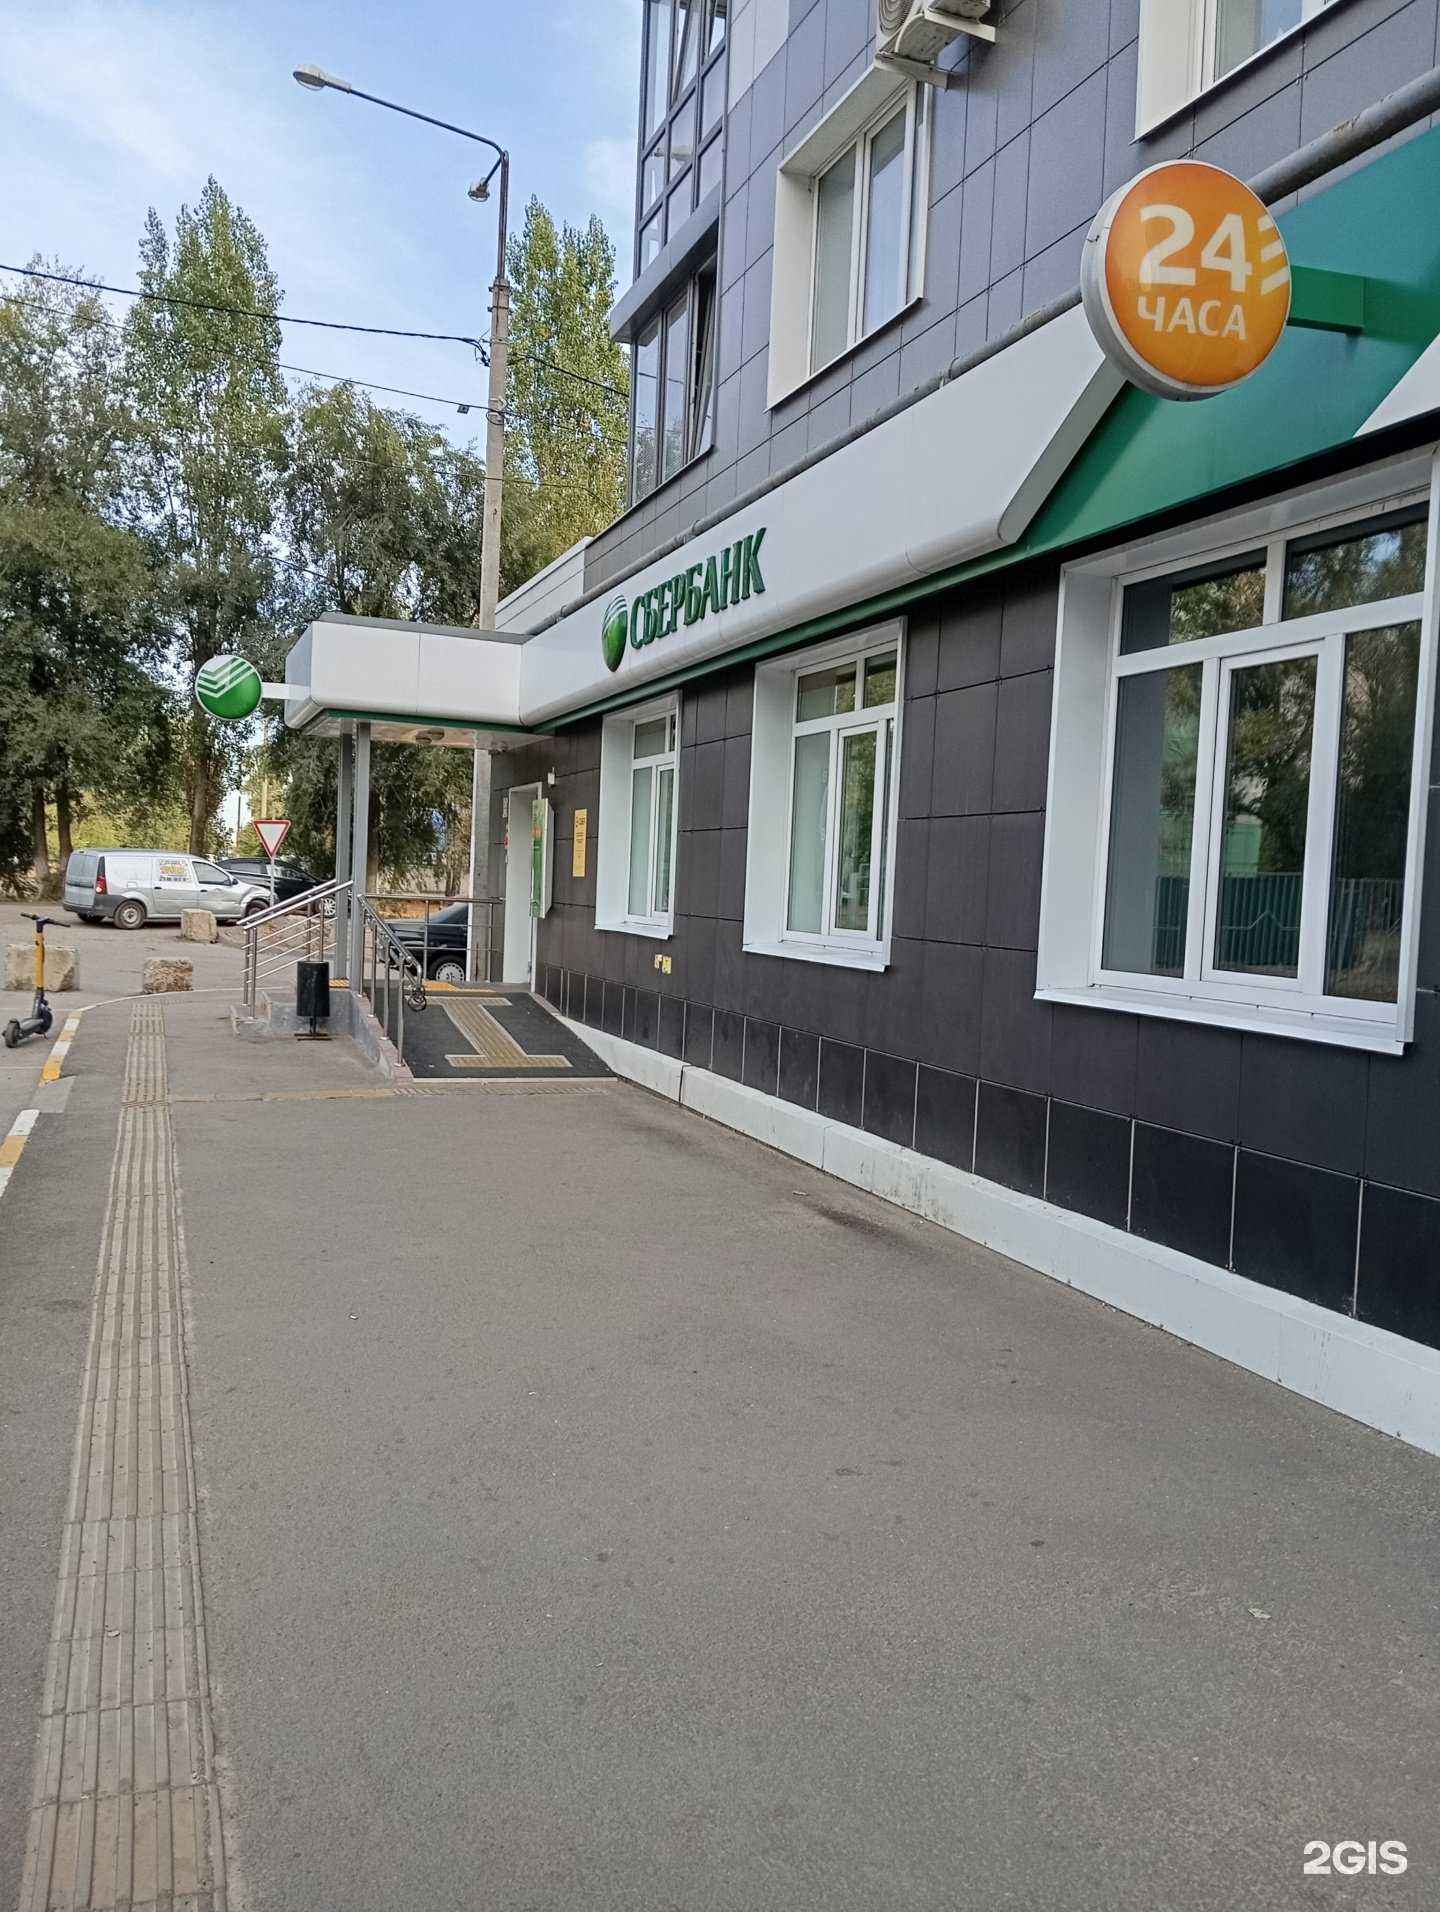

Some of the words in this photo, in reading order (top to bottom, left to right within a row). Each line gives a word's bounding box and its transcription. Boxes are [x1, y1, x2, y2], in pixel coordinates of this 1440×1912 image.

[1138, 203, 1253, 293] 24
[1136, 295, 1248, 341] ЧАСА
[630, 527, 767, 650] СБЕРБАНК
